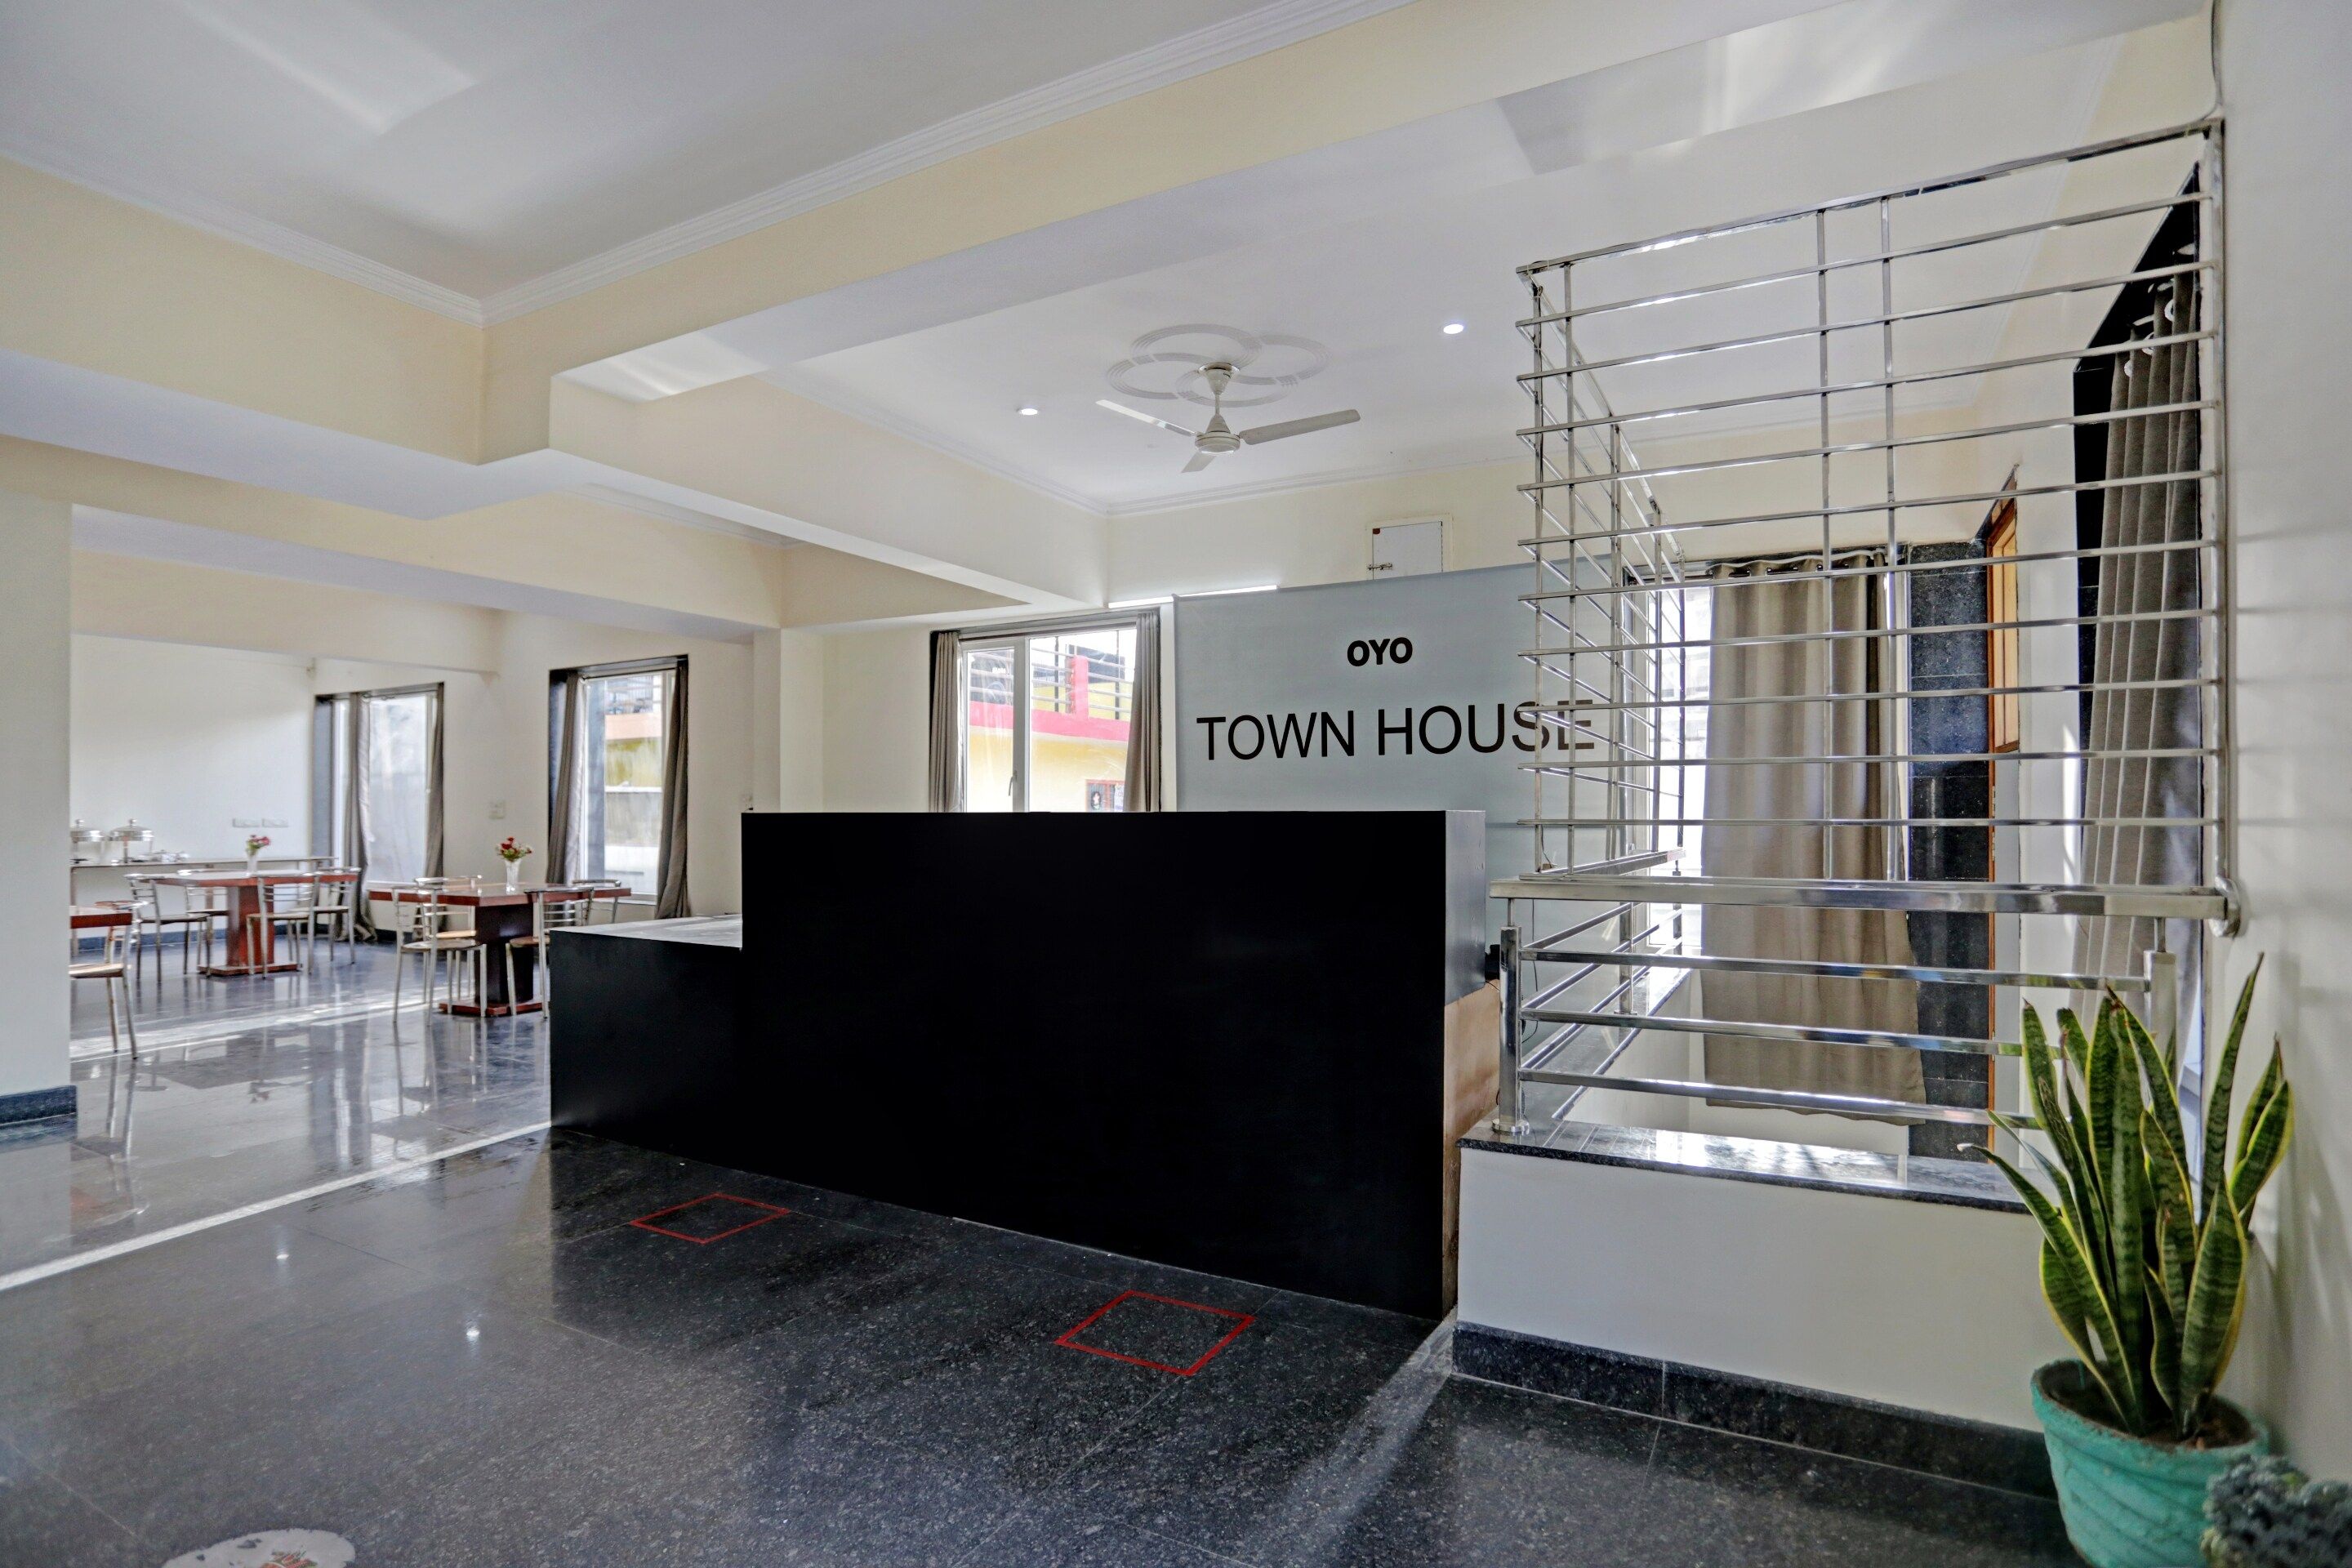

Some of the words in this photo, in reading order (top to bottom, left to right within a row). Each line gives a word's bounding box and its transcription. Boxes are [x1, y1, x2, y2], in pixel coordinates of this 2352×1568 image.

[1347, 637, 1414, 667] OYO
[1196, 710, 1355, 761] TOWN
[1378, 700, 1595, 756] HOUSE
